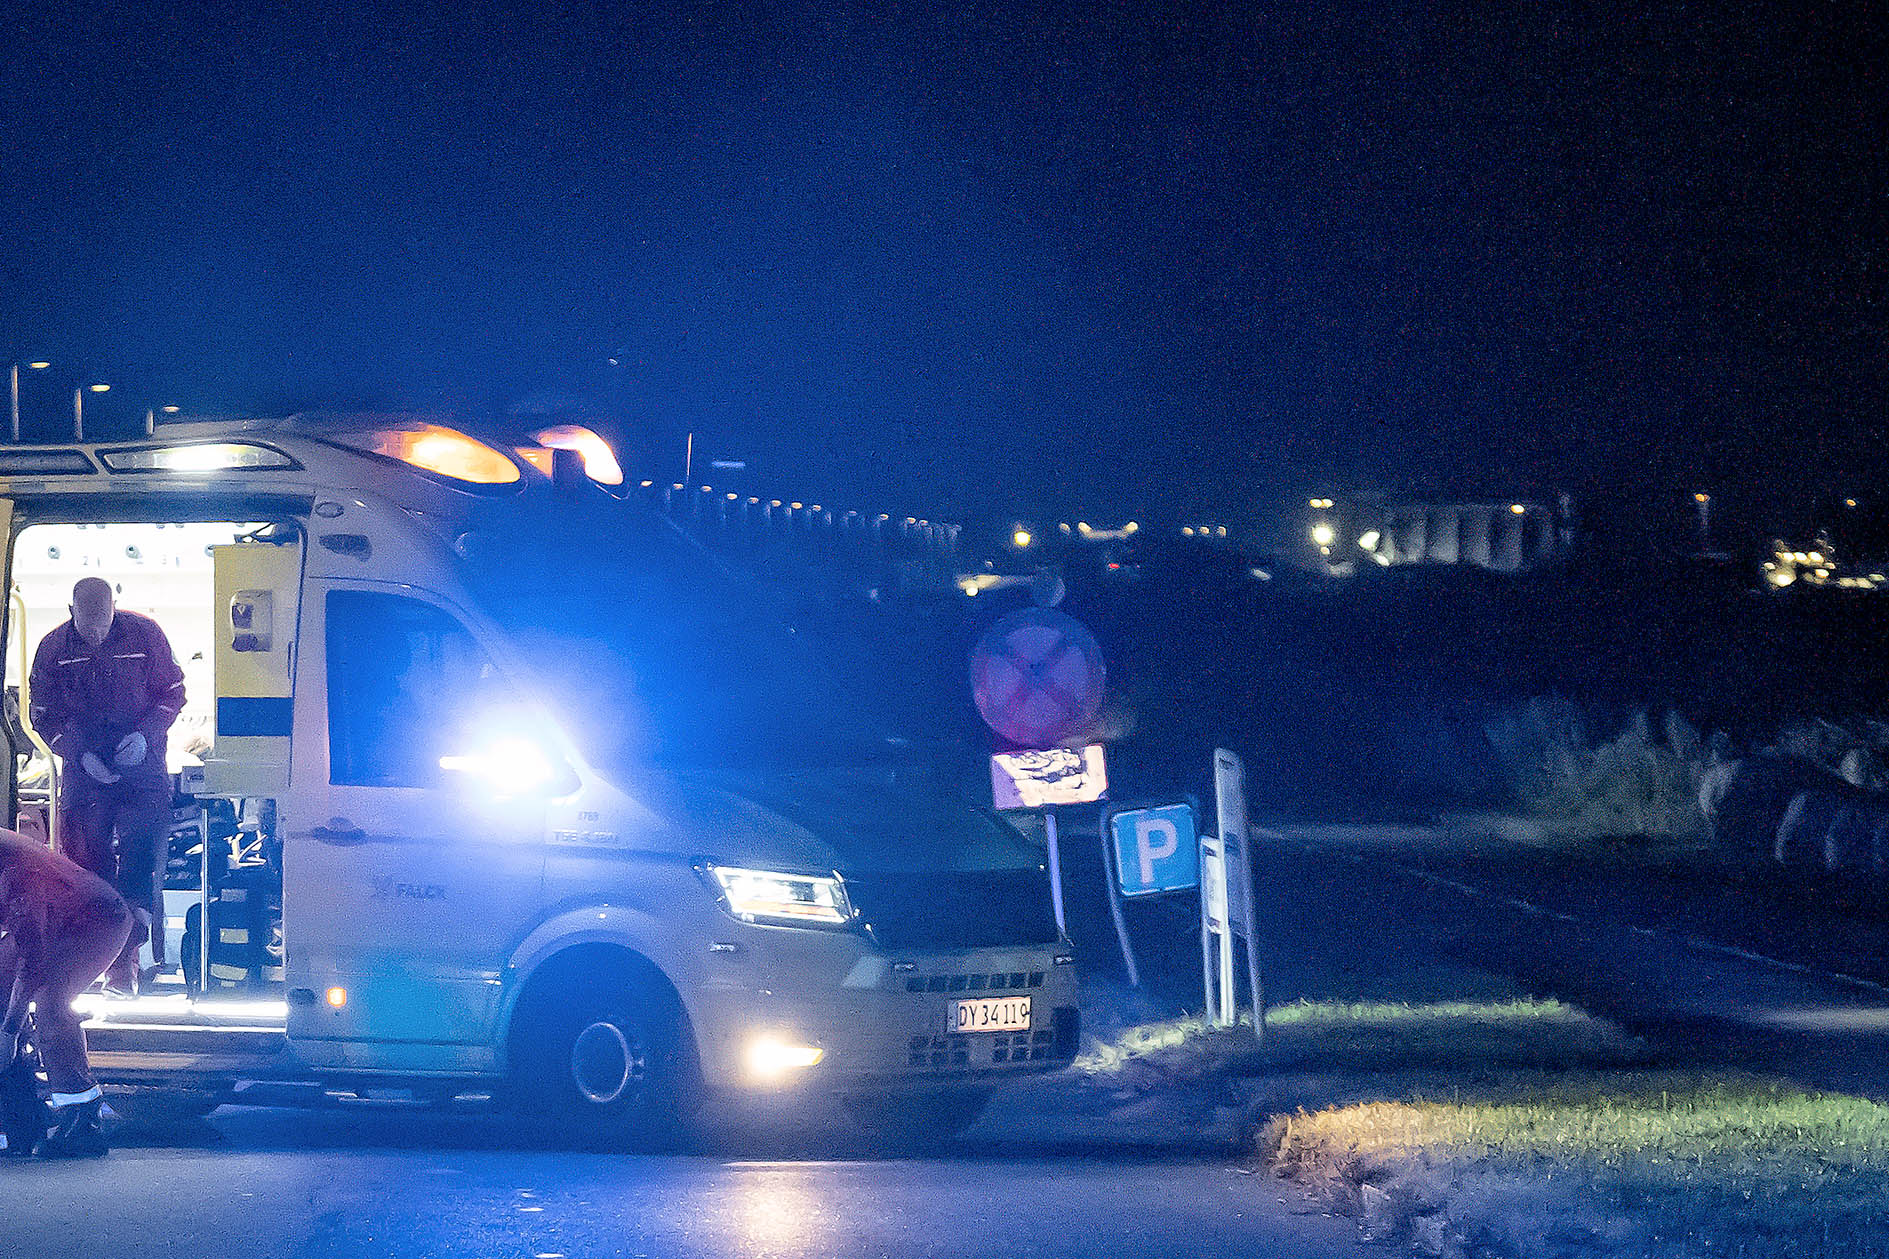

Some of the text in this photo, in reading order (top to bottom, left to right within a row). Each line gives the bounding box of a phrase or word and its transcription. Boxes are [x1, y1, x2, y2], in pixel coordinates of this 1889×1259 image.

[1135, 818, 1178, 884] P
[959, 1003, 1028, 1027] DY 34 119
